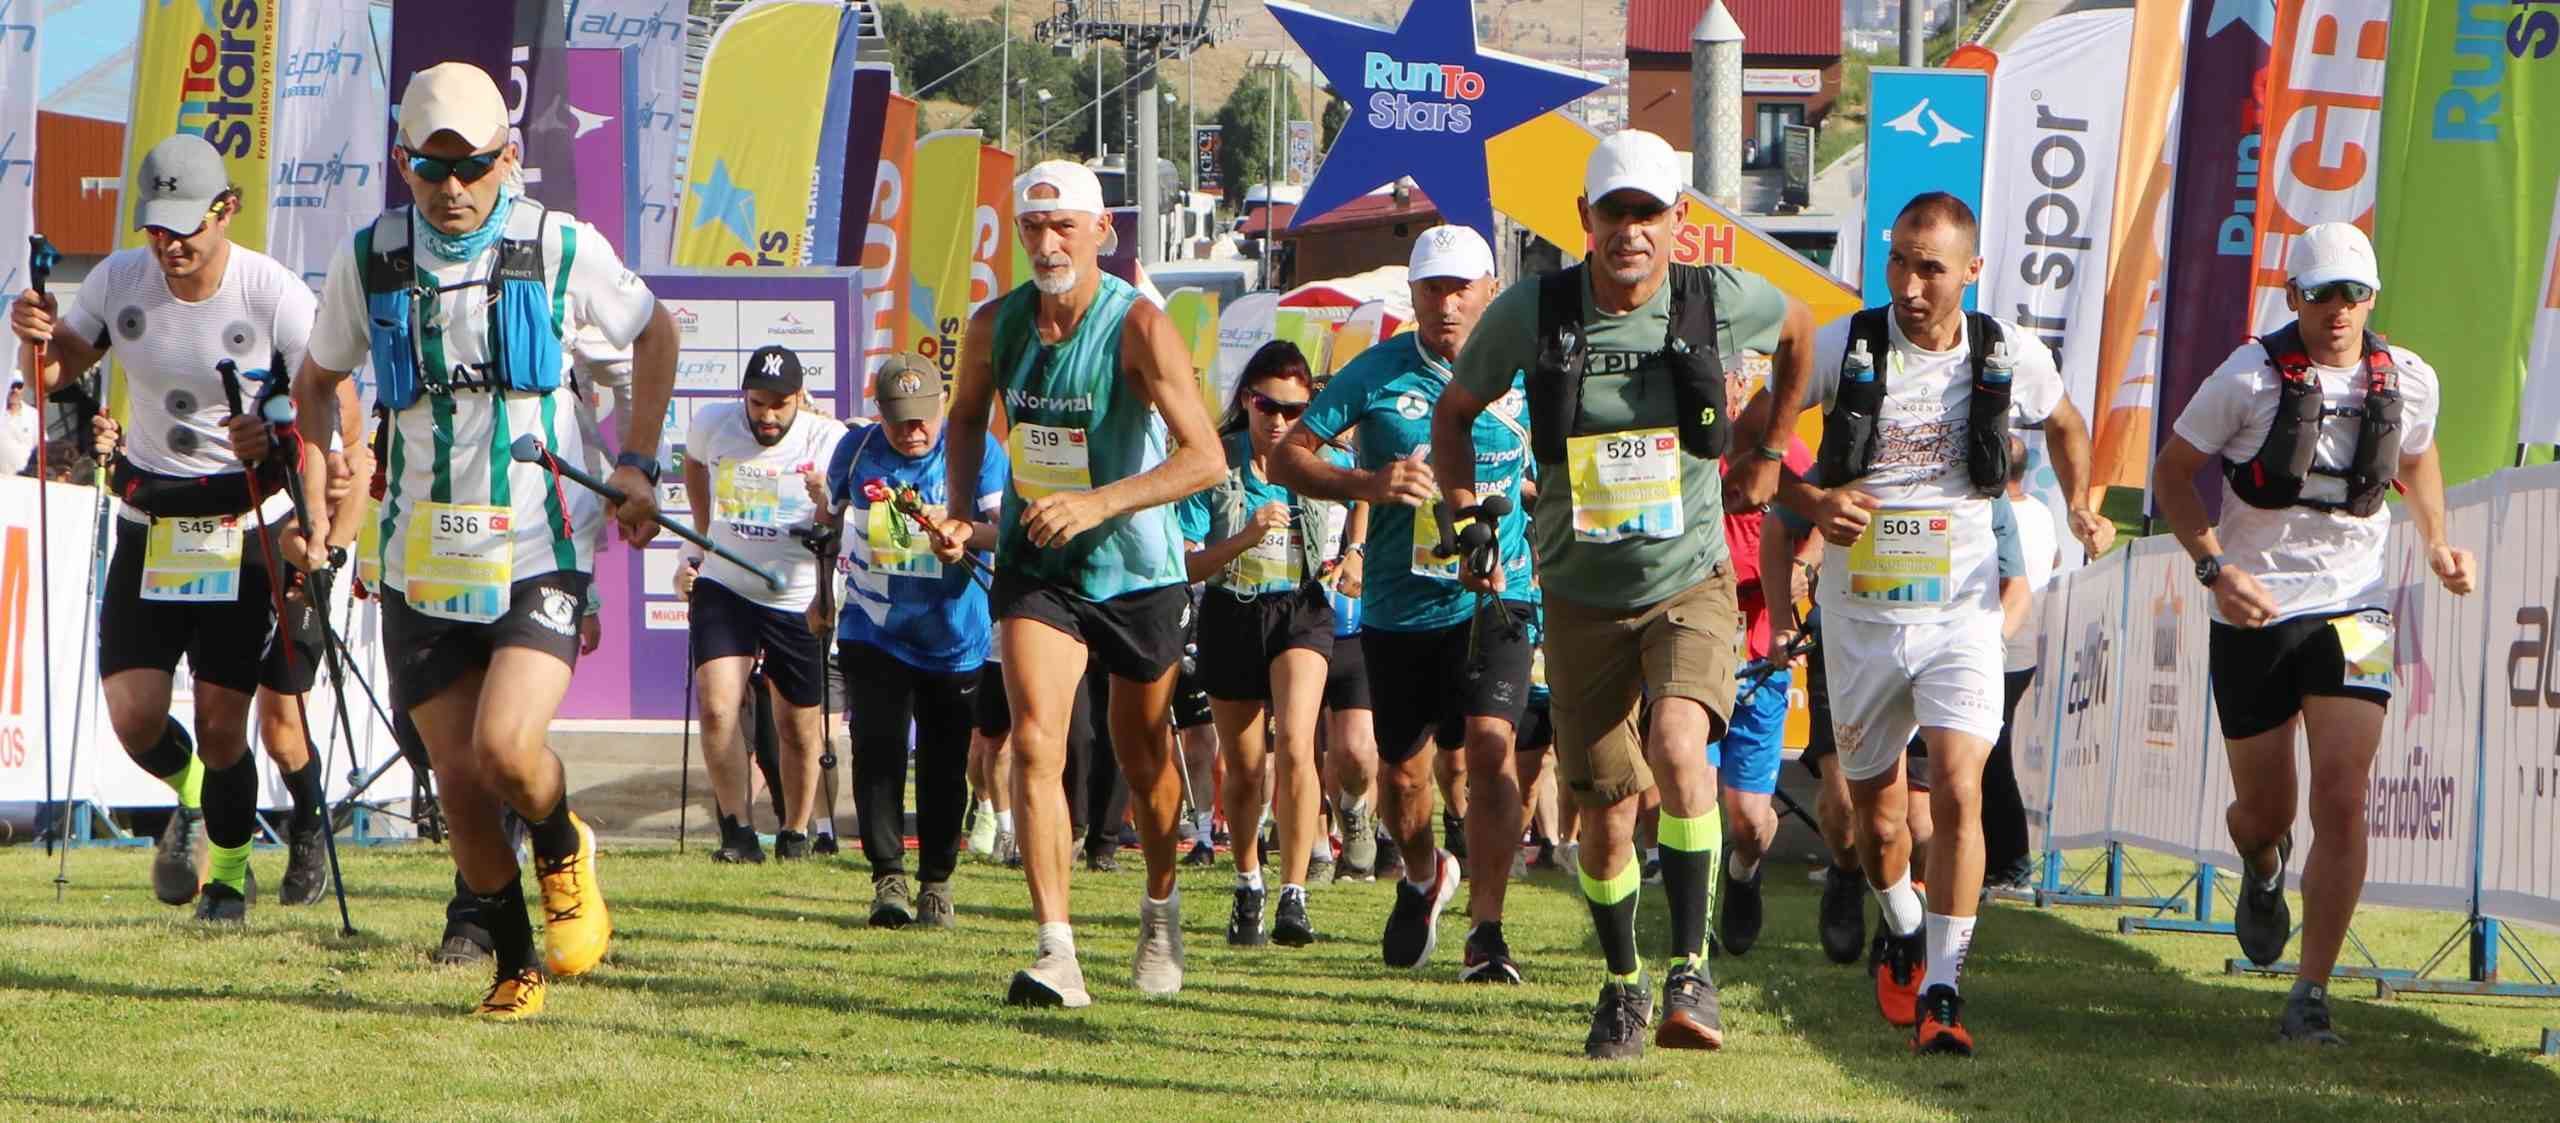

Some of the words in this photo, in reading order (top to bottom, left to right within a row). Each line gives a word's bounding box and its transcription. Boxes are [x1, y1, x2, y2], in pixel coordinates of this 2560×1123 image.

[262, 33, 273, 56] The
[261, 60, 271, 75] To
[1364, 51, 1485, 100] RunTo
[204, 0, 258, 158] Stars
[259, 78, 272, 124] History
[1368, 92, 1472, 133] Stars
[257, 127, 268, 159] From
[2020, 105, 2092, 290] spor
[1031, 430, 1059, 446] 519
[1607, 440, 1646, 459] 528
[738, 467, 760, 479] 520
[178, 520, 214, 534] 545
[440, 514, 479, 534] 536
[1883, 520, 1921, 536] 503
[1261, 534, 1285, 547] 34
